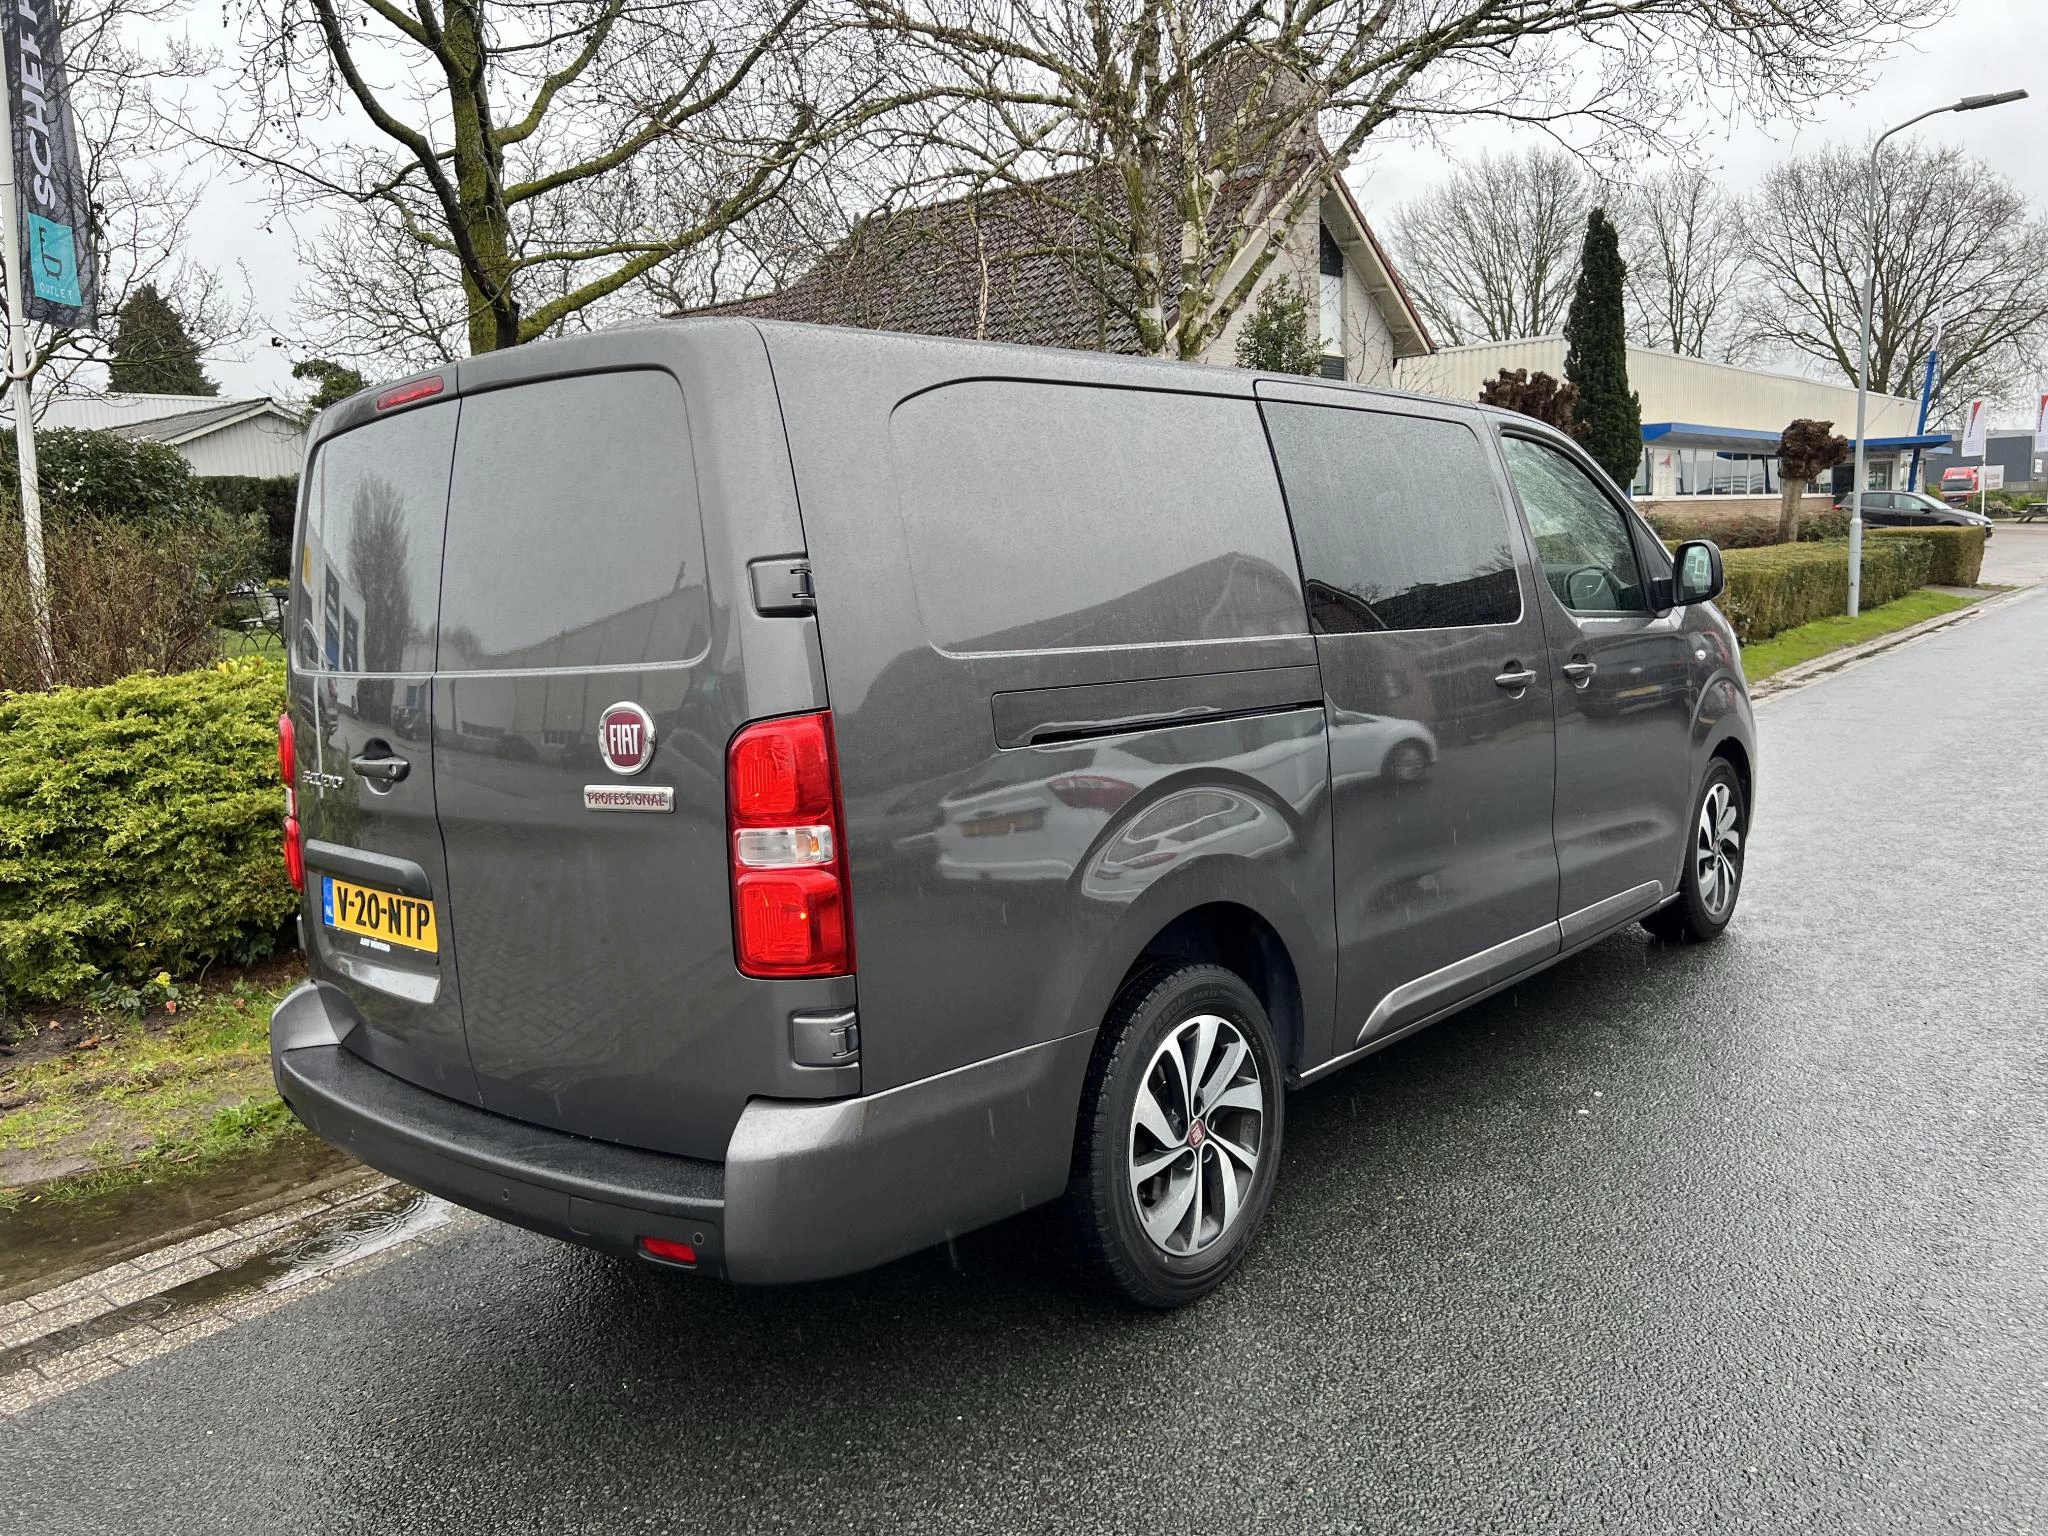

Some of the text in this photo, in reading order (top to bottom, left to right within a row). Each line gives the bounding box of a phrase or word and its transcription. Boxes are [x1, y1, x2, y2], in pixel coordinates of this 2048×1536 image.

[39, 283, 74, 300] OUTLET
[609, 724, 640, 755] FIAT
[588, 793, 666, 807] PROFESSIONAL
[337, 887, 430, 940] V-20-NTP
